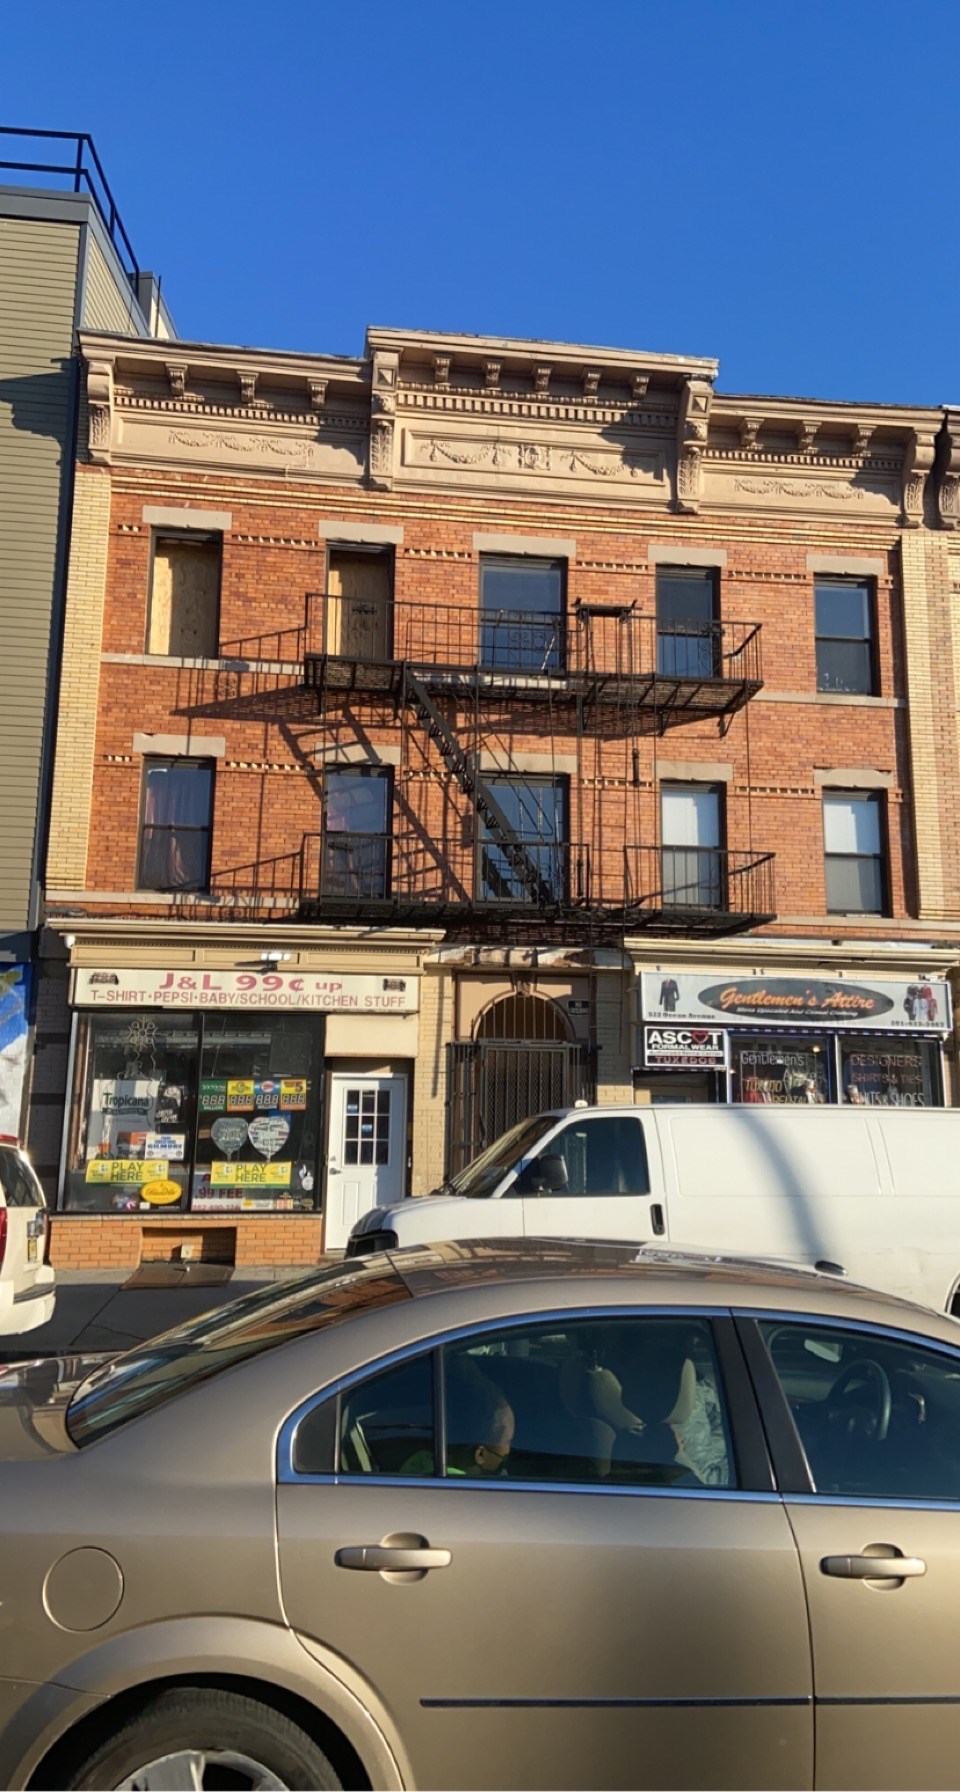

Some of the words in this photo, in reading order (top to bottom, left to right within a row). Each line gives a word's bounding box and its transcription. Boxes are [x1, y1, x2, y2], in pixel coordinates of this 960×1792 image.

[159, 973, 222, 990] J&L
[236, 975, 304, 992] 99¢
[315, 981, 342, 993] up
[365, 996, 405, 1007] STUFF
[720, 986, 817, 1010] Gentlemen's
[821, 991, 875, 1009] Attire
[655, 1056, 716, 1064] TUXEDOS
[741, 1051, 805, 1066] Gentlemen's
[102, 1092, 150, 1108] Tropicana
[111, 1162, 144, 1171] PLAY
[236, 1163, 268, 1172] PLAY
[111, 1171, 143, 1181] HERE
[236, 1173, 266, 1182] HERE
[218, 1188, 243, 1199] FEE
